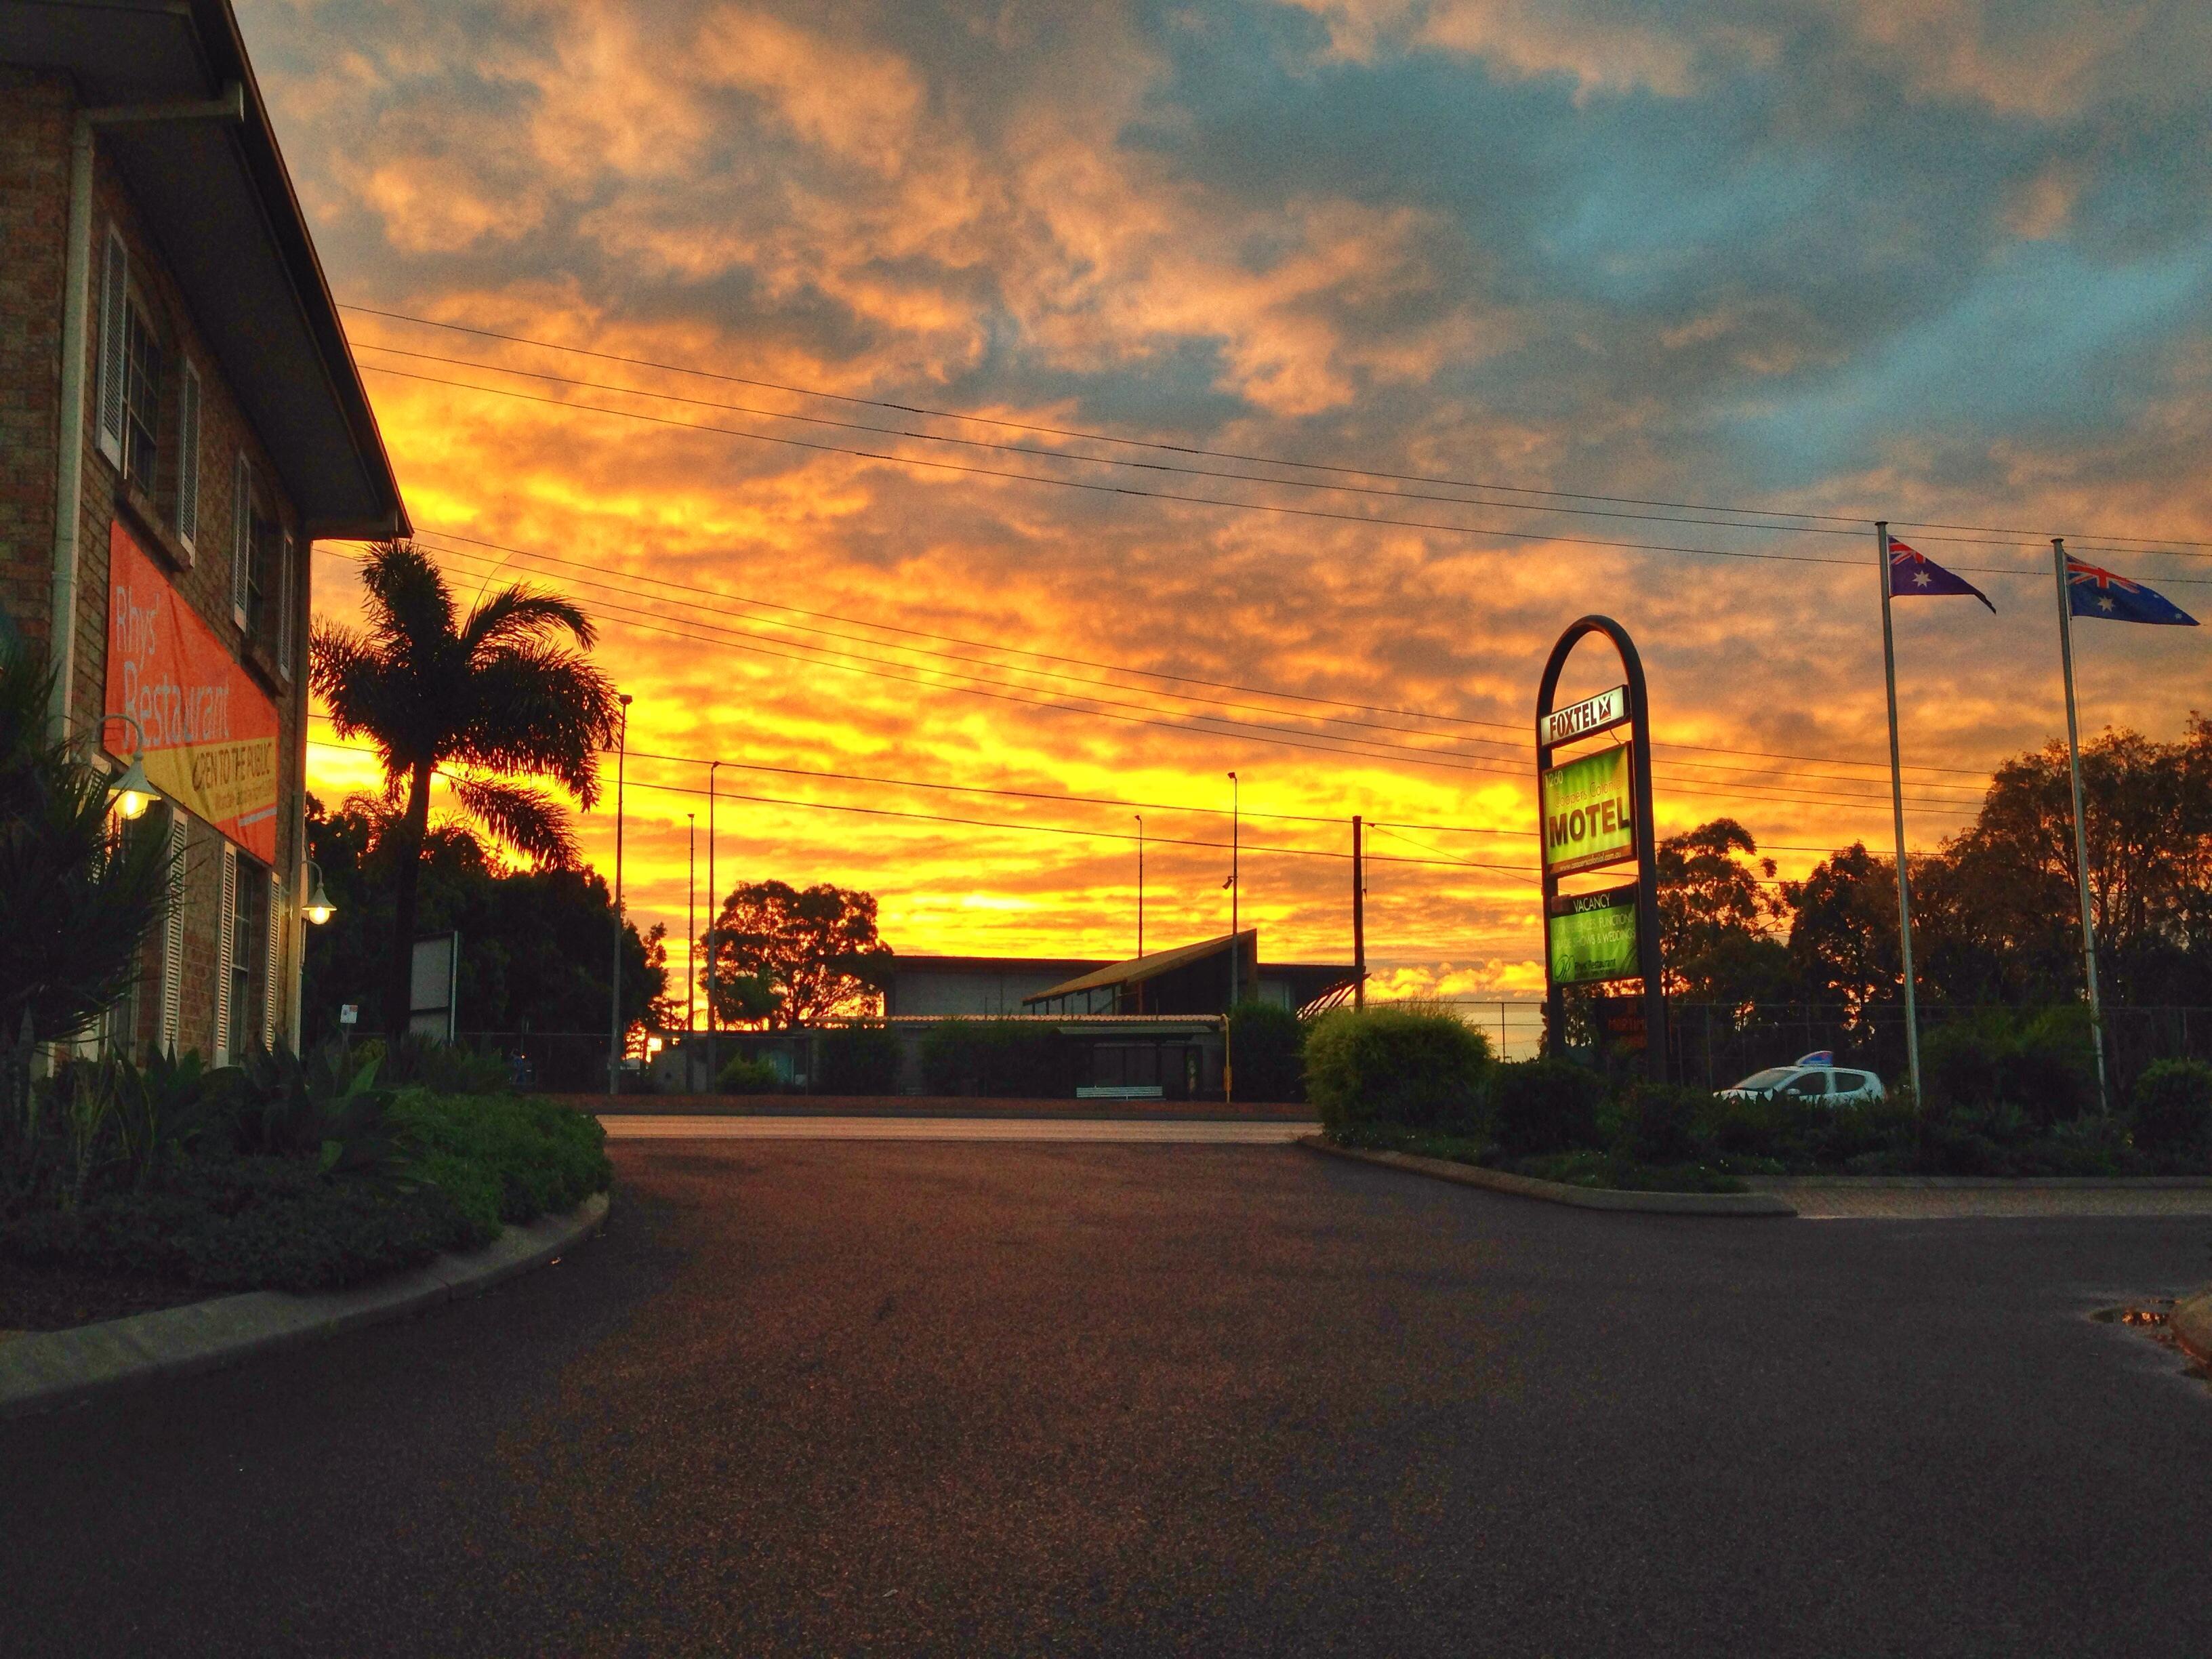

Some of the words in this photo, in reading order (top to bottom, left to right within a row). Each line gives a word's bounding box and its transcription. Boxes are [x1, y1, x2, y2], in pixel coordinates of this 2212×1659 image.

[124, 661, 230, 748] Restaurant
[1550, 701, 1597, 741] FOXTEL
[218, 748, 230, 785] TO
[1544, 771, 1563, 788] 1260
[1555, 791, 1587, 808] Coopers
[1549, 796, 1630, 847] MOTEL
[1573, 893, 1610, 912] VACANCY
